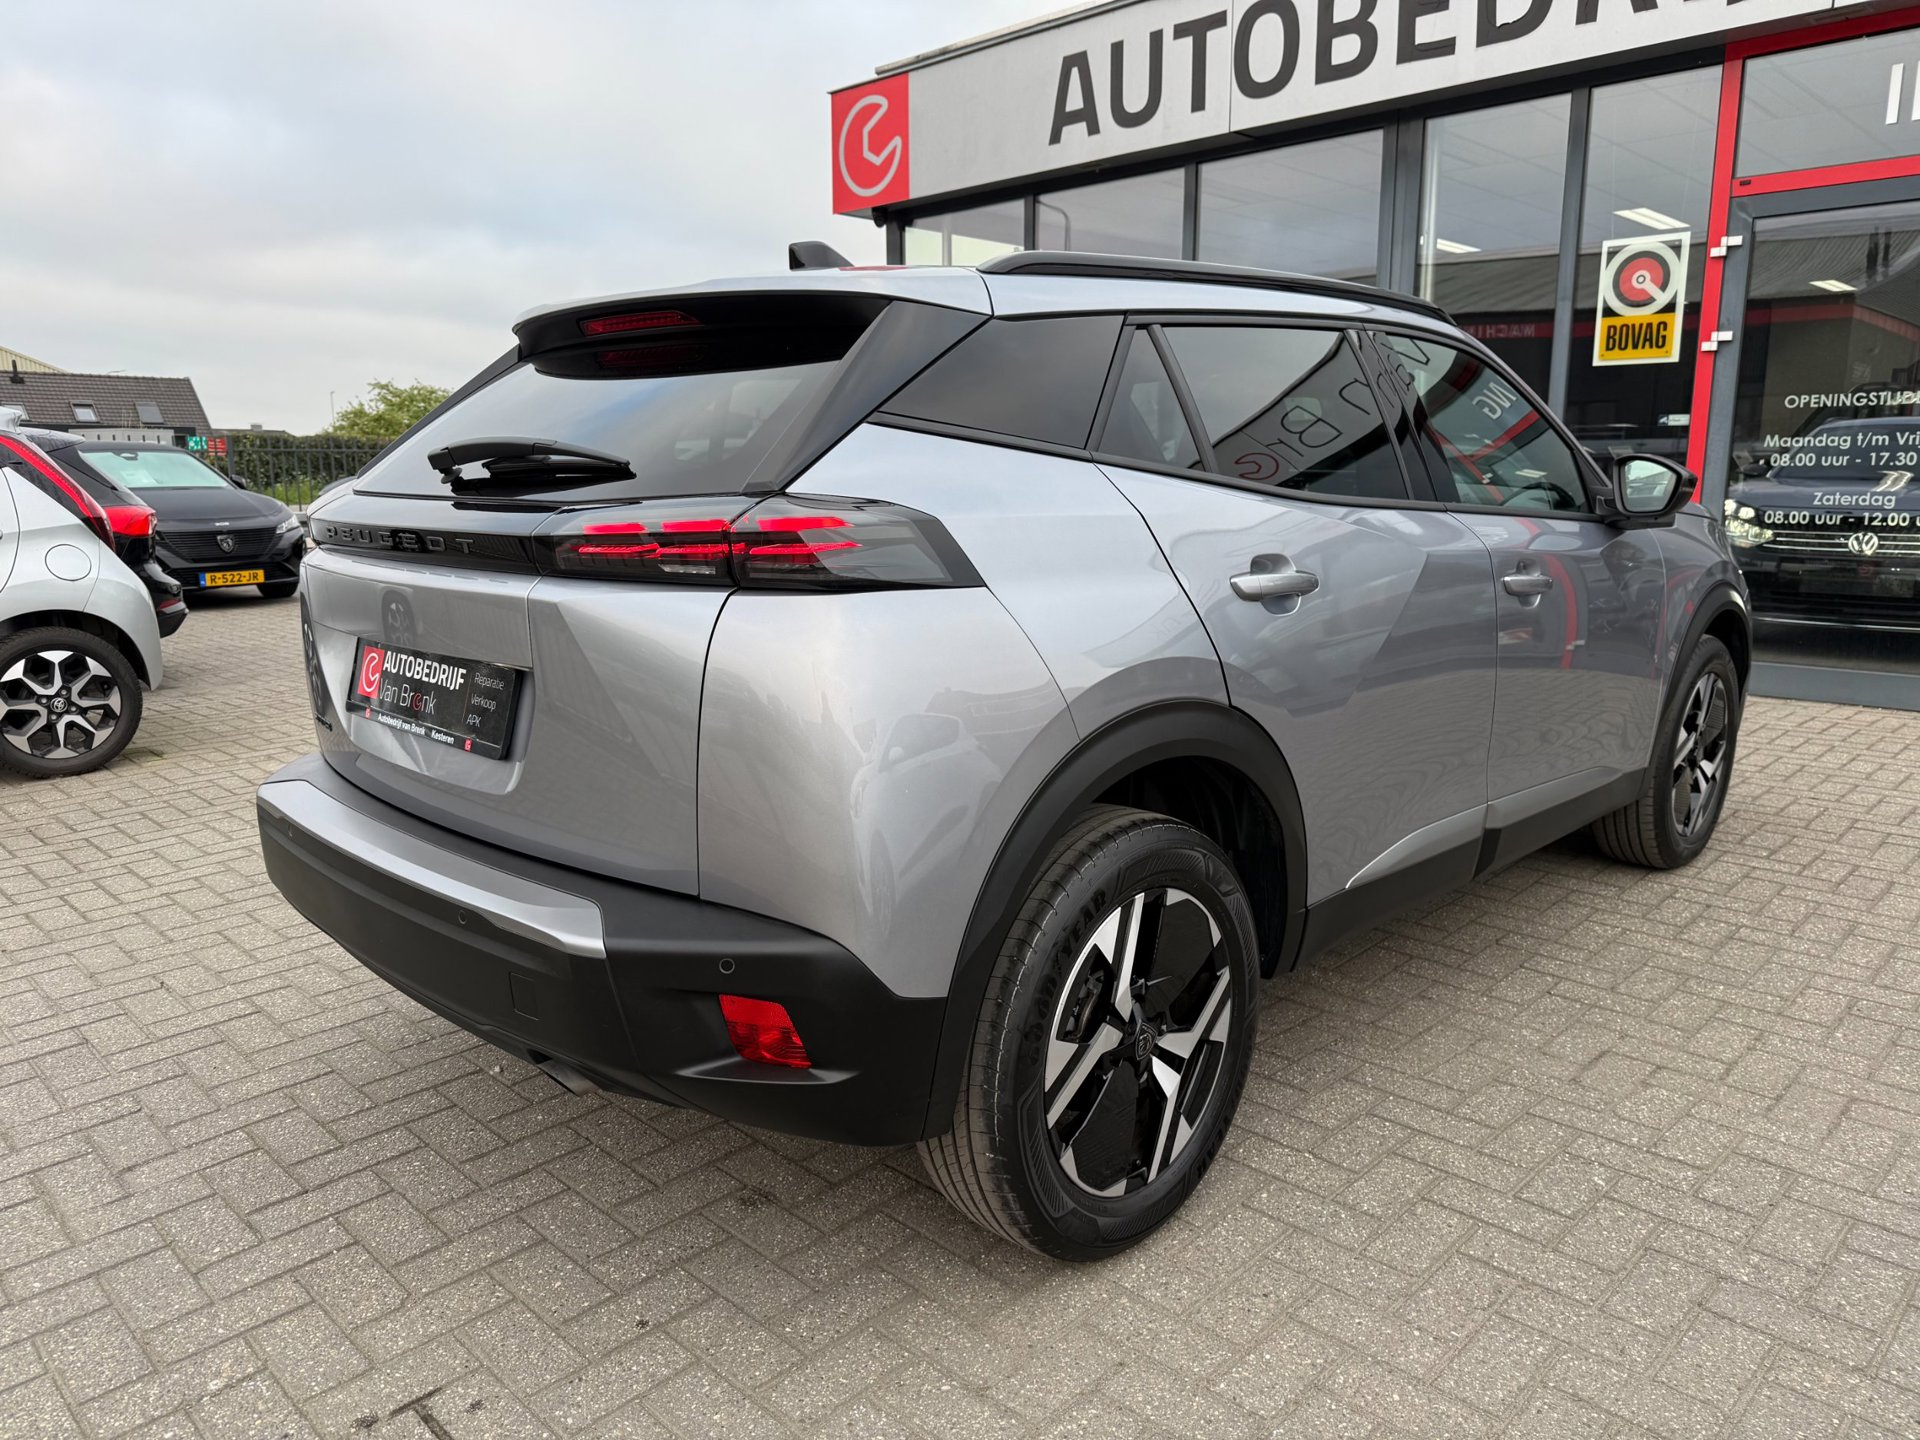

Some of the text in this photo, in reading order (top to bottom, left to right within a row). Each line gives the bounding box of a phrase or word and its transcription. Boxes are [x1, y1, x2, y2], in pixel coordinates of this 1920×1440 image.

[1048, 0, 1747, 146] AUTOBE
[1605, 321, 1667, 351] BOVAG
[1784, 391, 1920, 408] OPENINGSTIJD
[1764, 432, 1850, 449] Maandag
[1857, 432, 1889, 448] t/m
[1770, 453, 1816, 466] 08.00
[1821, 454, 1850, 466] uur
[1869, 452, 1917, 466] 17.30
[1813, 492, 1896, 509] Zaterdag
[1764, 511, 1810, 524] 08.00
[1815, 514, 1843, 525] uur
[1863, 512, 1910, 526] 12.00
[326, 526, 475, 553] PEUGEOT
[210, 571, 259, 584] R-522-JR
[383, 651, 467, 690] AUTOBEDRIJF
[380, 678, 398, 703] Van
[471, 693, 497, 712] Verkoop
[378, 713, 455, 744] Autobedrijf van Brenk Kesteren
[466, 714, 482, 727] APK
